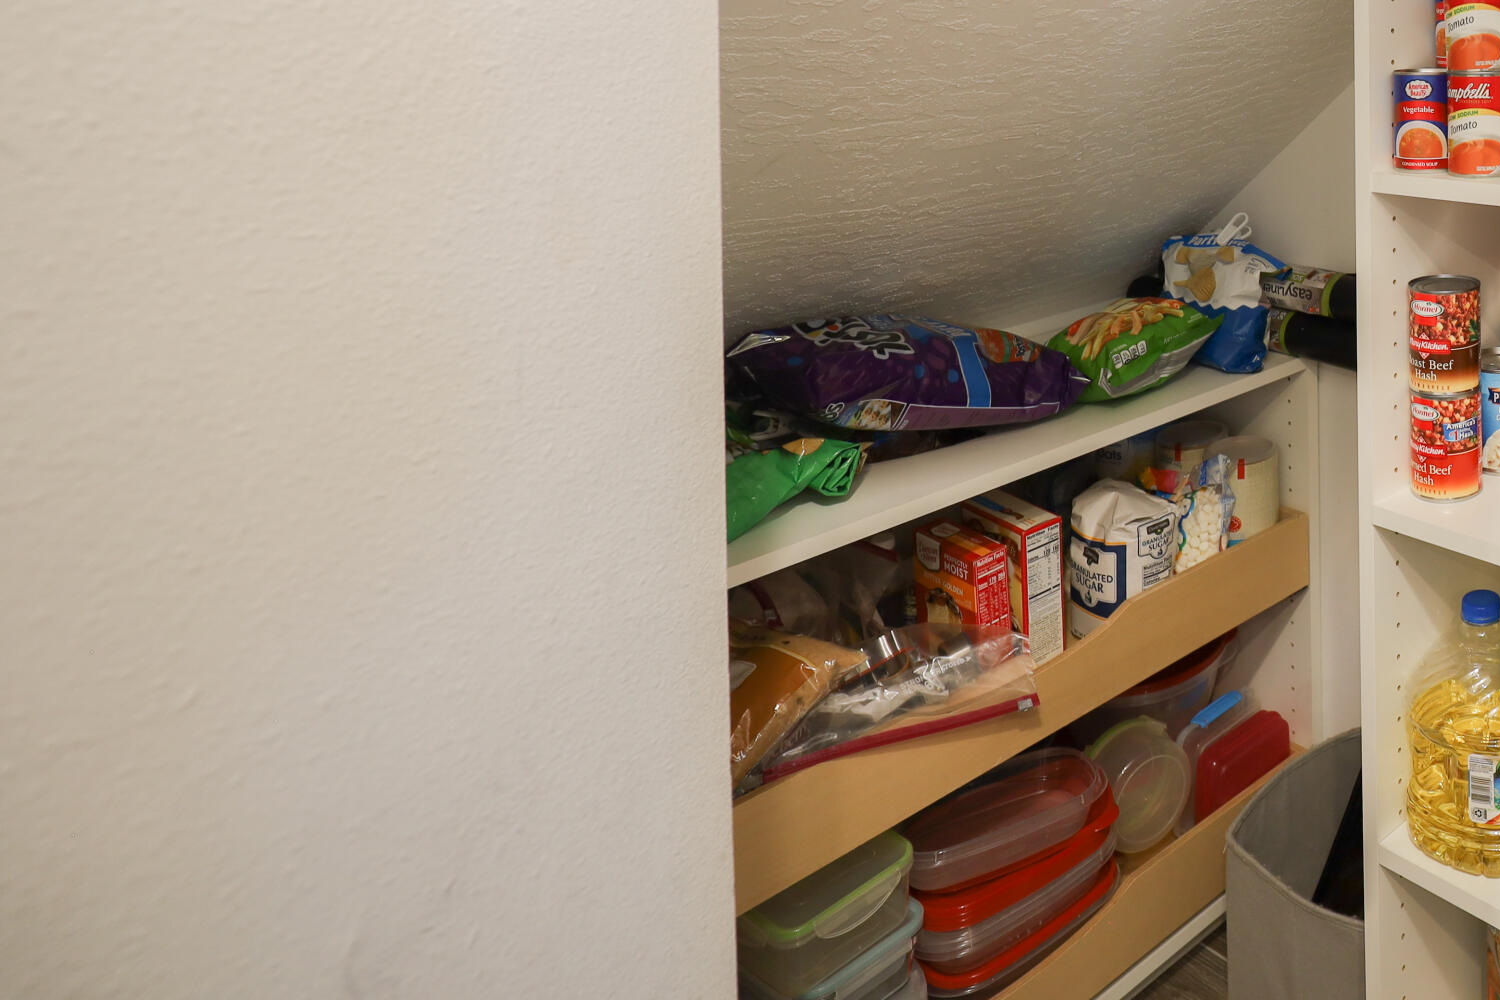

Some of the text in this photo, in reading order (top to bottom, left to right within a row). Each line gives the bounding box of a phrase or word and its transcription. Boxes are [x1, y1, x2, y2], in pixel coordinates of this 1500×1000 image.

[1448, 16, 1474, 32] Tomato
[1403, 106, 1434, 115] Vegetable
[1451, 121, 1477, 135] Tomato
[1414, 303, 1438, 312] Hormel
[1415, 368, 1437, 381] Hash
[1447, 419, 1475, 430] America's
[1420, 445, 1444, 455] Kitchen
[1414, 472, 1434, 486] Hash
[1149, 537, 1170, 551] SUGAR
[943, 552, 968, 569] PERFECTLY
[976, 551, 1004, 567] Nutrition Facts
[944, 561, 968, 580] MOIST
[1075, 573, 1104, 594] SUGAR
